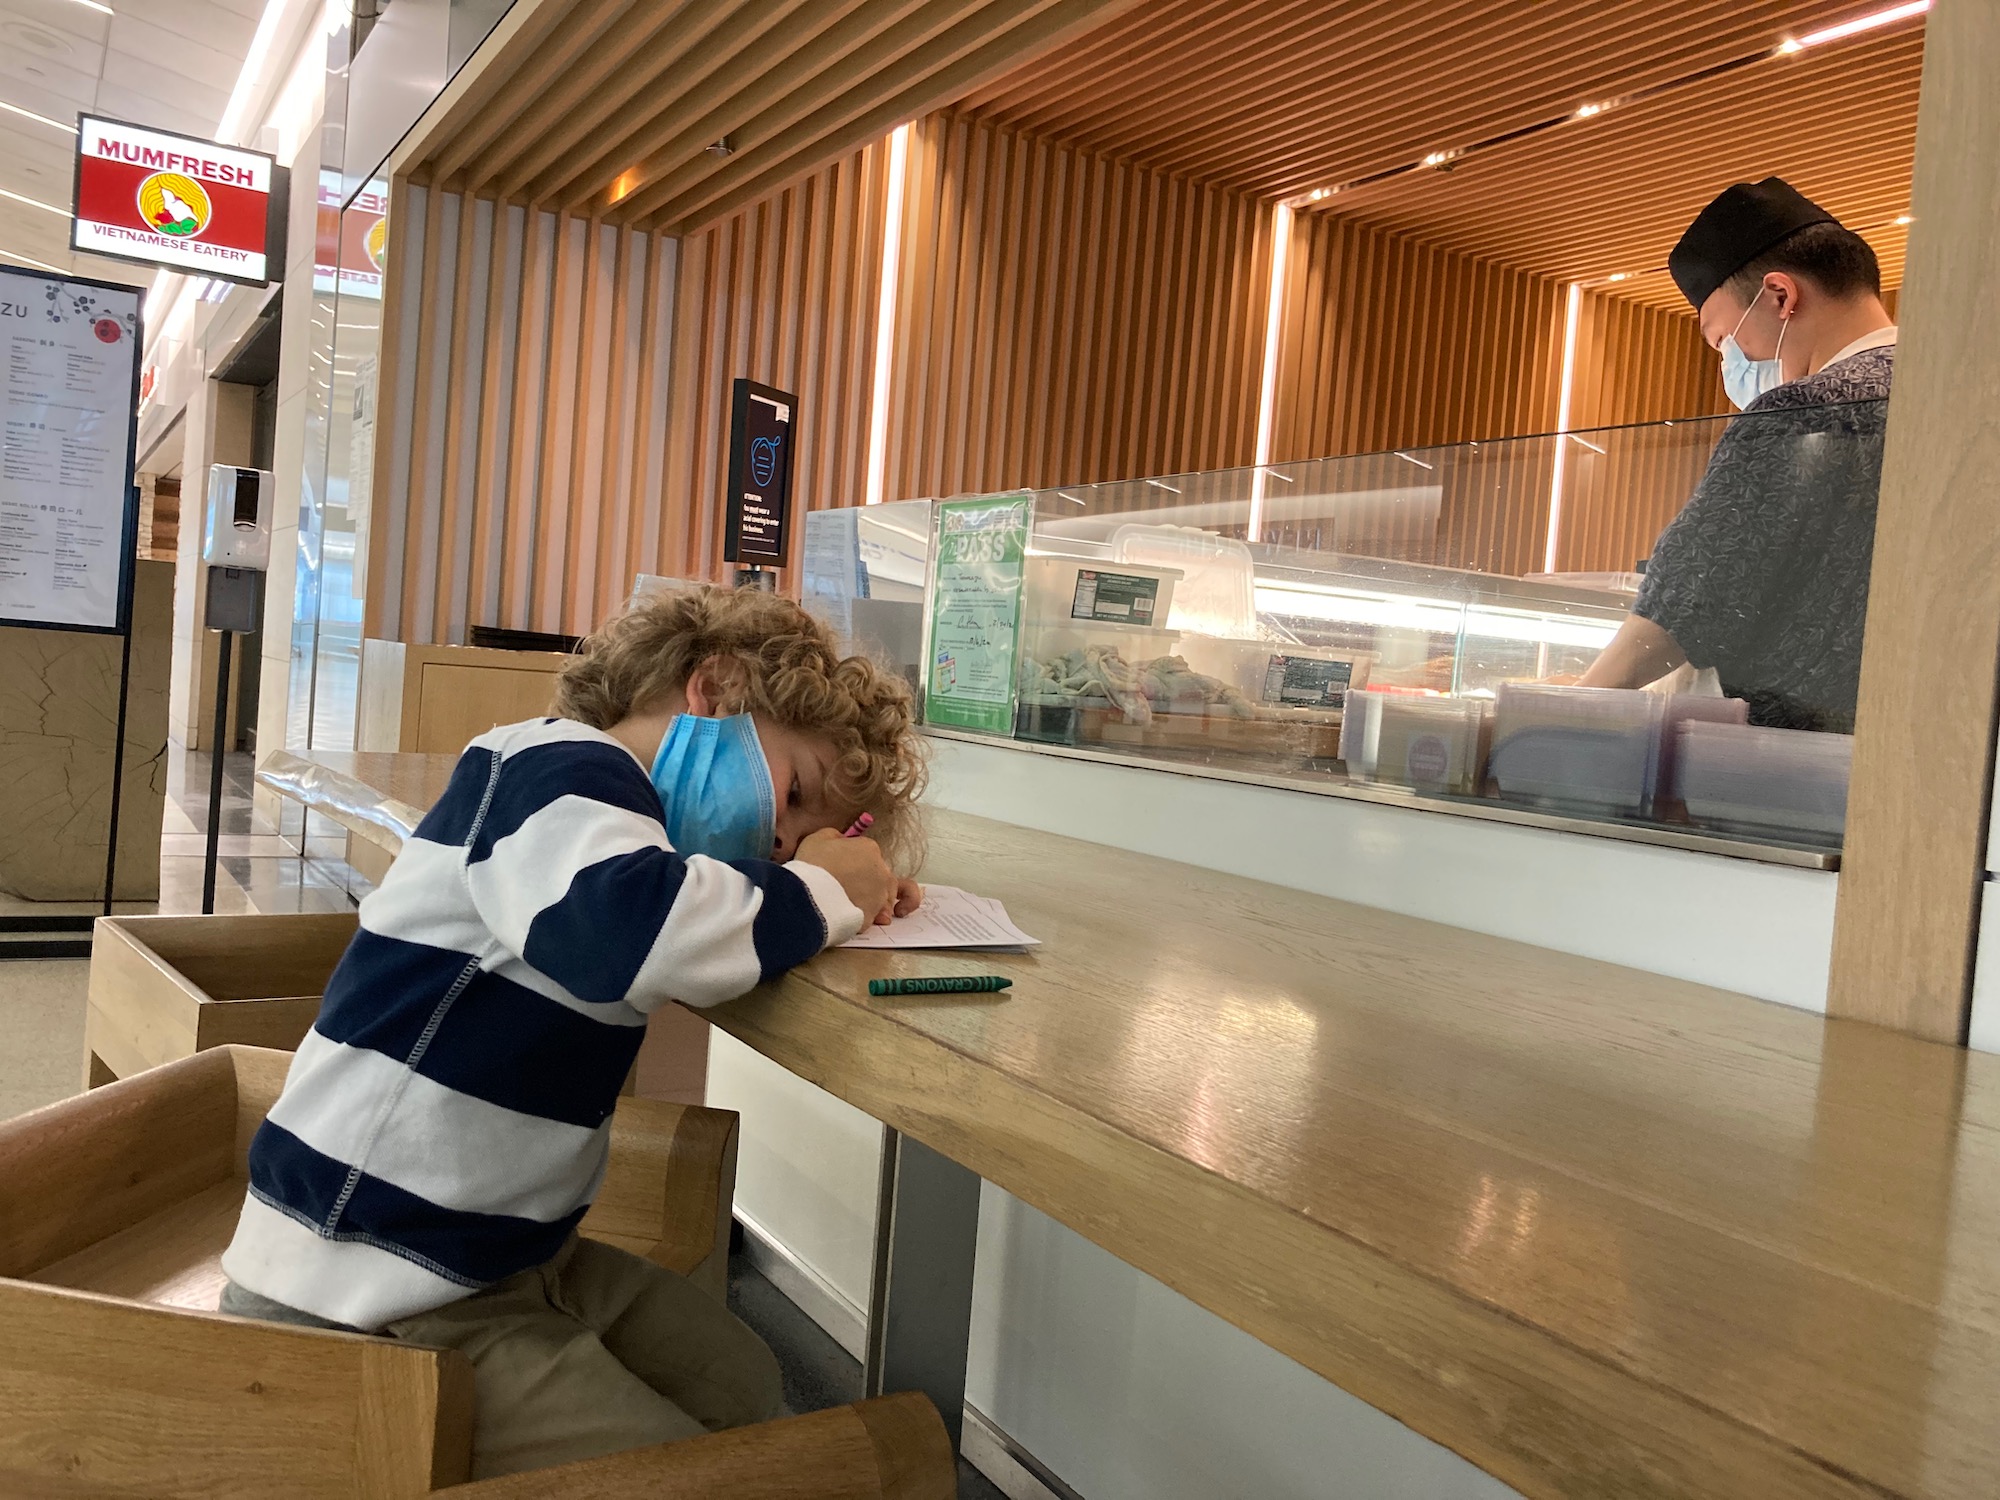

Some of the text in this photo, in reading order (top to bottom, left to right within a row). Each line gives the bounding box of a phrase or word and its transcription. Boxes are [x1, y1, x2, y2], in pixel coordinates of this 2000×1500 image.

[97, 137, 254, 187] MUMFRESH
[93, 224, 249, 262] VIETNAMESE EATERY
[0, 302, 28, 318] ZU
[955, 534, 1006, 562] PASS
[906, 979, 973, 993] CRAYONS
